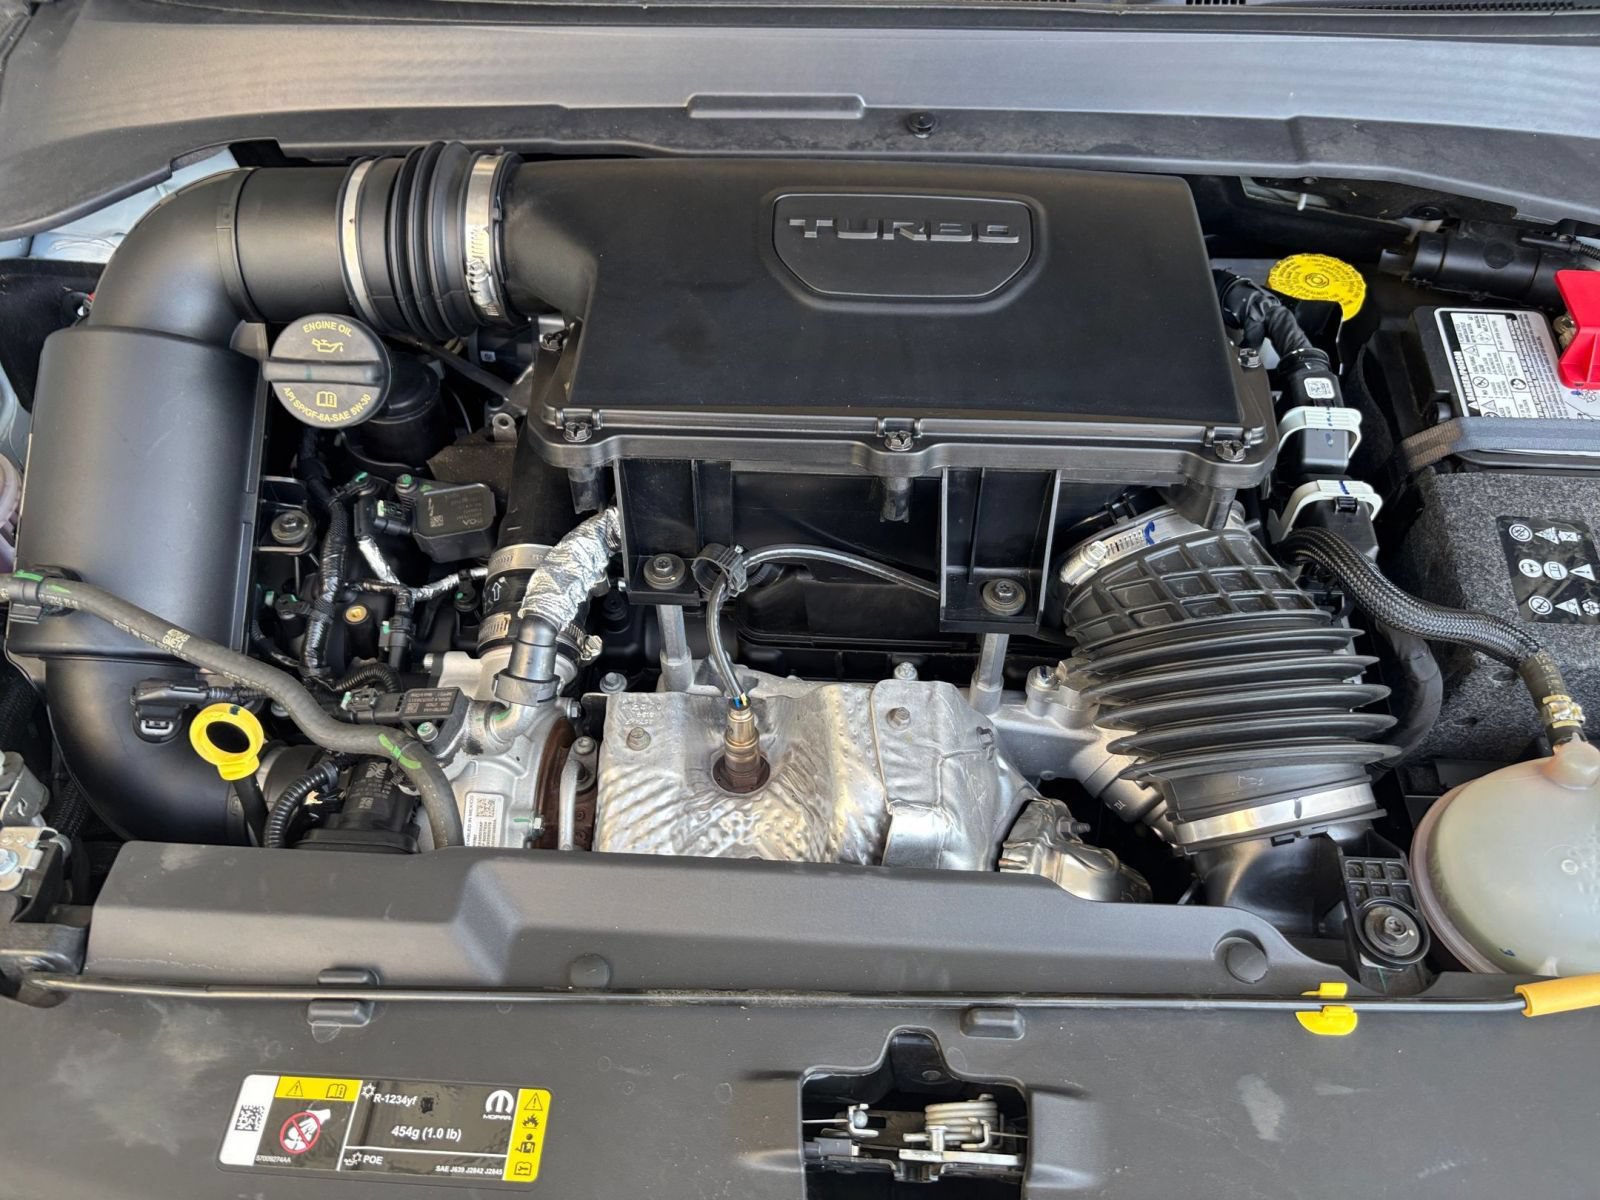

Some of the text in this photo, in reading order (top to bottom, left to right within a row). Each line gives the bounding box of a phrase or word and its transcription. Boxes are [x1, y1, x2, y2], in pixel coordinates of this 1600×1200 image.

[789, 218, 1020, 243] TURBO
[303, 320, 352, 337] ENGINE OIL
[284, 387, 295, 401] API
[351, 394, 371, 415] 5W-30
[373, 1093, 418, 1107] R-1234yf
[391, 1125, 462, 1142] 454g (1.0 lb)
[363, 1155, 383, 1165] POE
